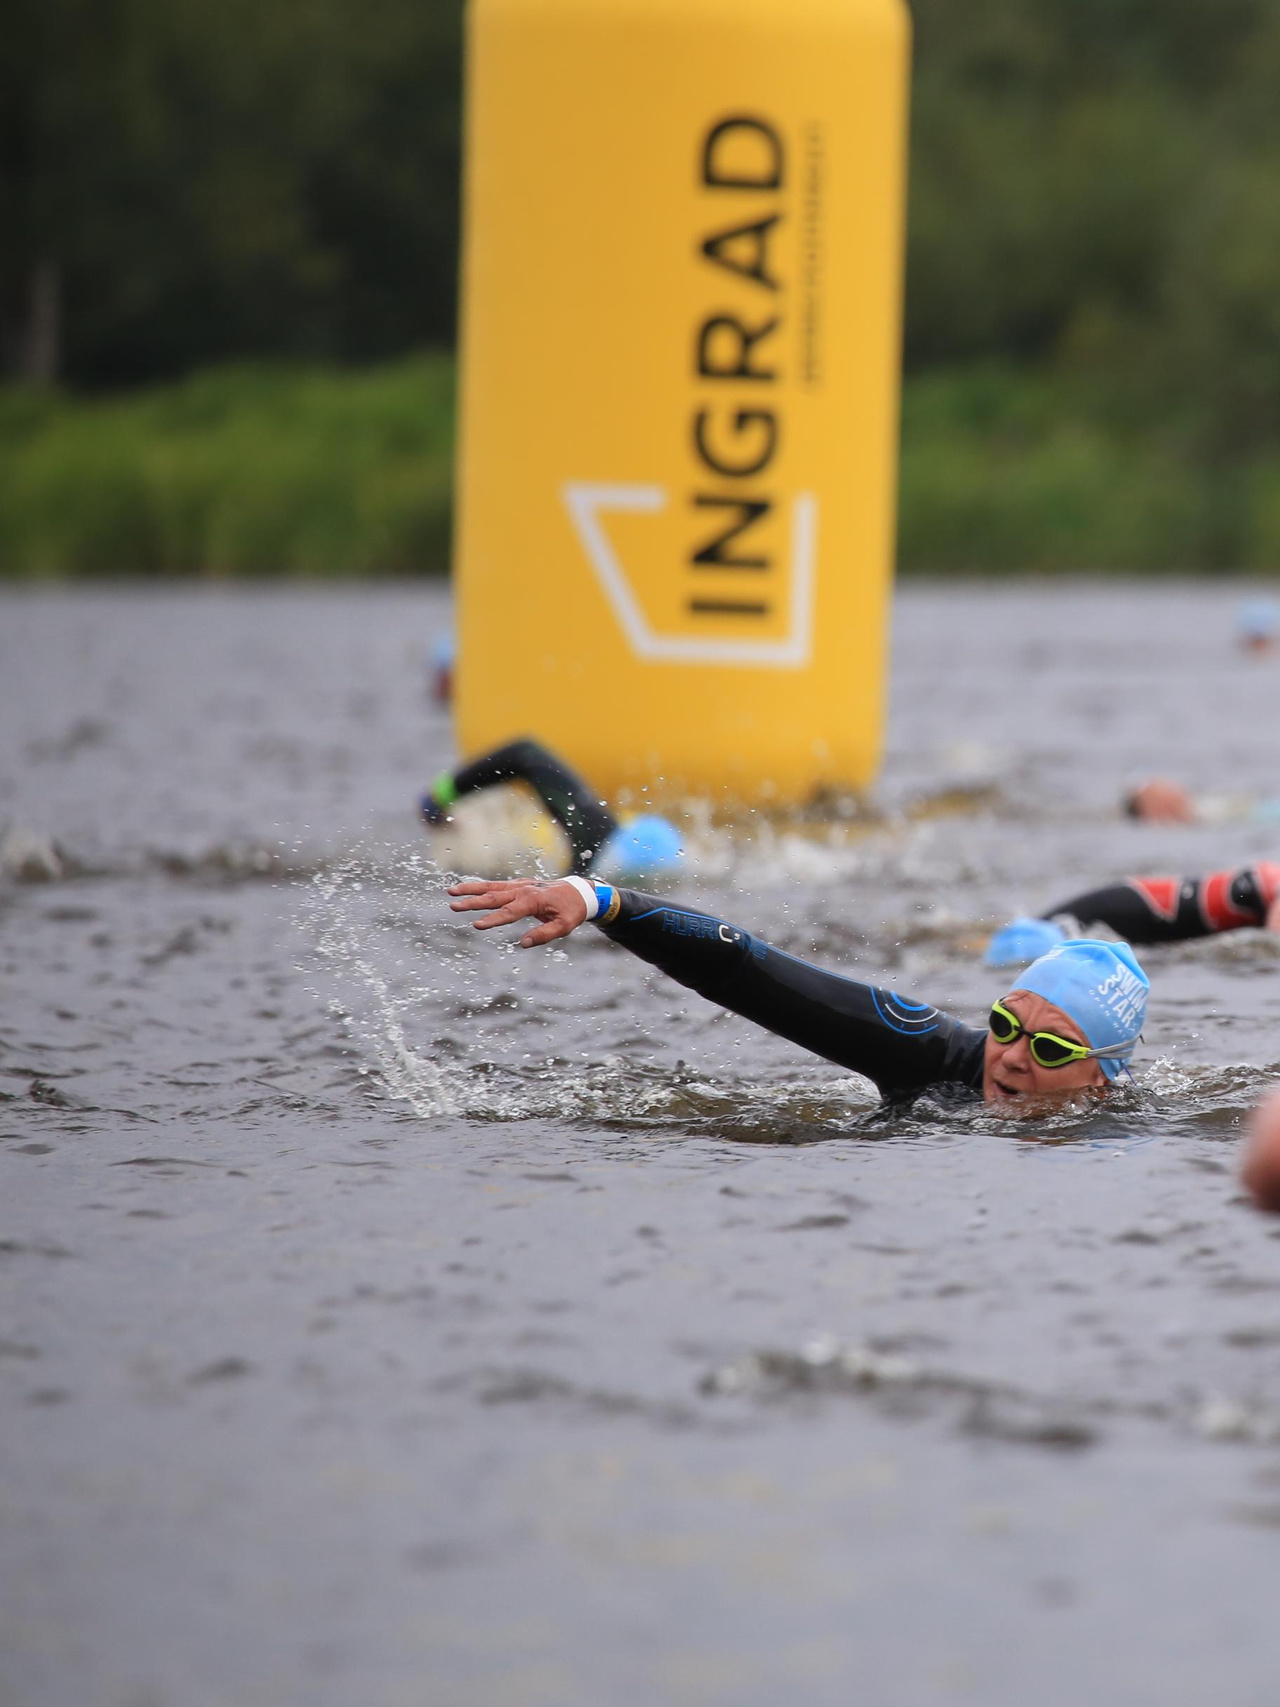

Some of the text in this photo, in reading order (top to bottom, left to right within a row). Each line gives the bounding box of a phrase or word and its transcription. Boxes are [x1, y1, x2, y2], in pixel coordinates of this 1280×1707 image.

[690, 114, 786, 617] INGRAD
[1097, 978, 1136, 1028] STAR
[1111, 963, 1147, 1012] SWIM
